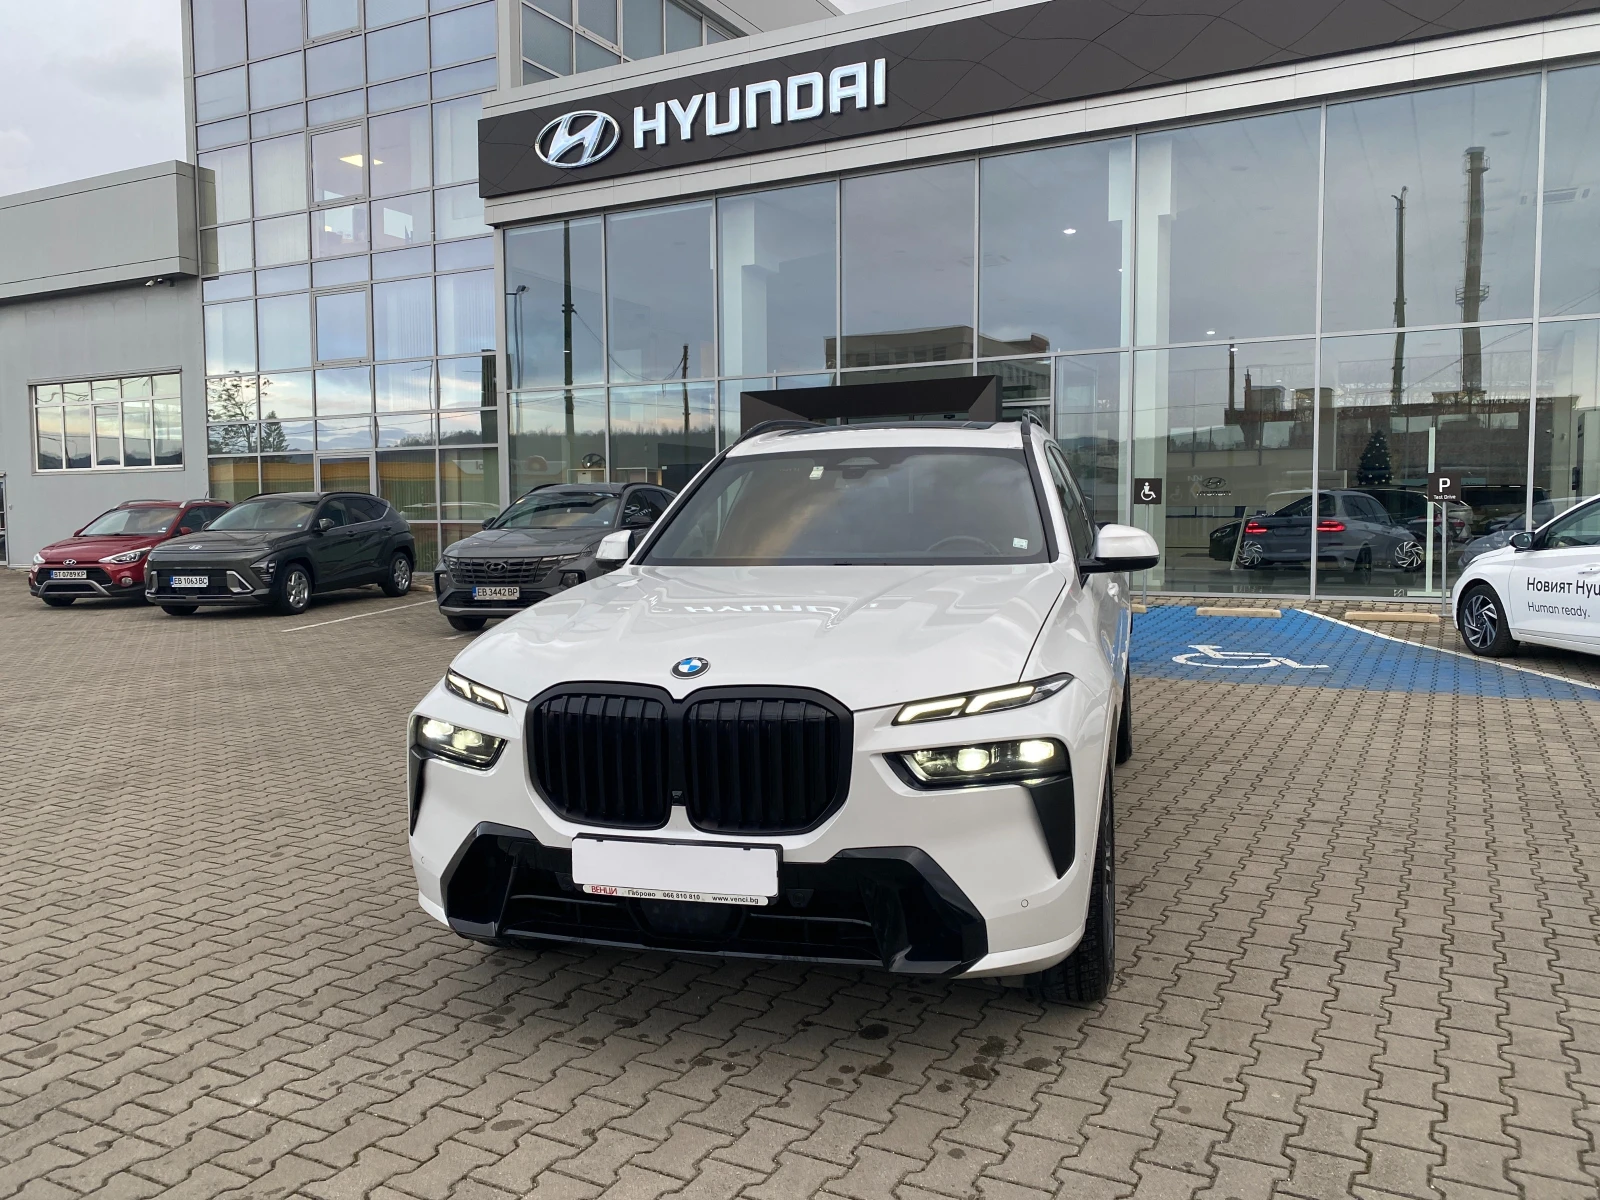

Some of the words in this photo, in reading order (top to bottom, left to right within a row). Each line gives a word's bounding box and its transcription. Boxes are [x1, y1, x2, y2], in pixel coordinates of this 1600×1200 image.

[633, 58, 887, 149] HYUNDAI
[1438, 477, 1451, 493] P
[174, 577, 183, 585] EB
[183, 577, 198, 585] 1063
[198, 577, 208, 585] BC
[1527, 576, 1573, 594] Новият
[477, 588, 488, 597] EB
[488, 588, 507, 597] 3442
[507, 588, 518, 597] BP
[1527, 600, 1560, 615] Human
[1561, 604, 1591, 620] ready.
[591, 885, 618, 896] ВЕНЦИ
[627, 889, 657, 898] Габрово
[662, 891, 675, 899] 066
[675, 892, 688, 900] 810
[711, 895, 759, 905] www.venci.bg
